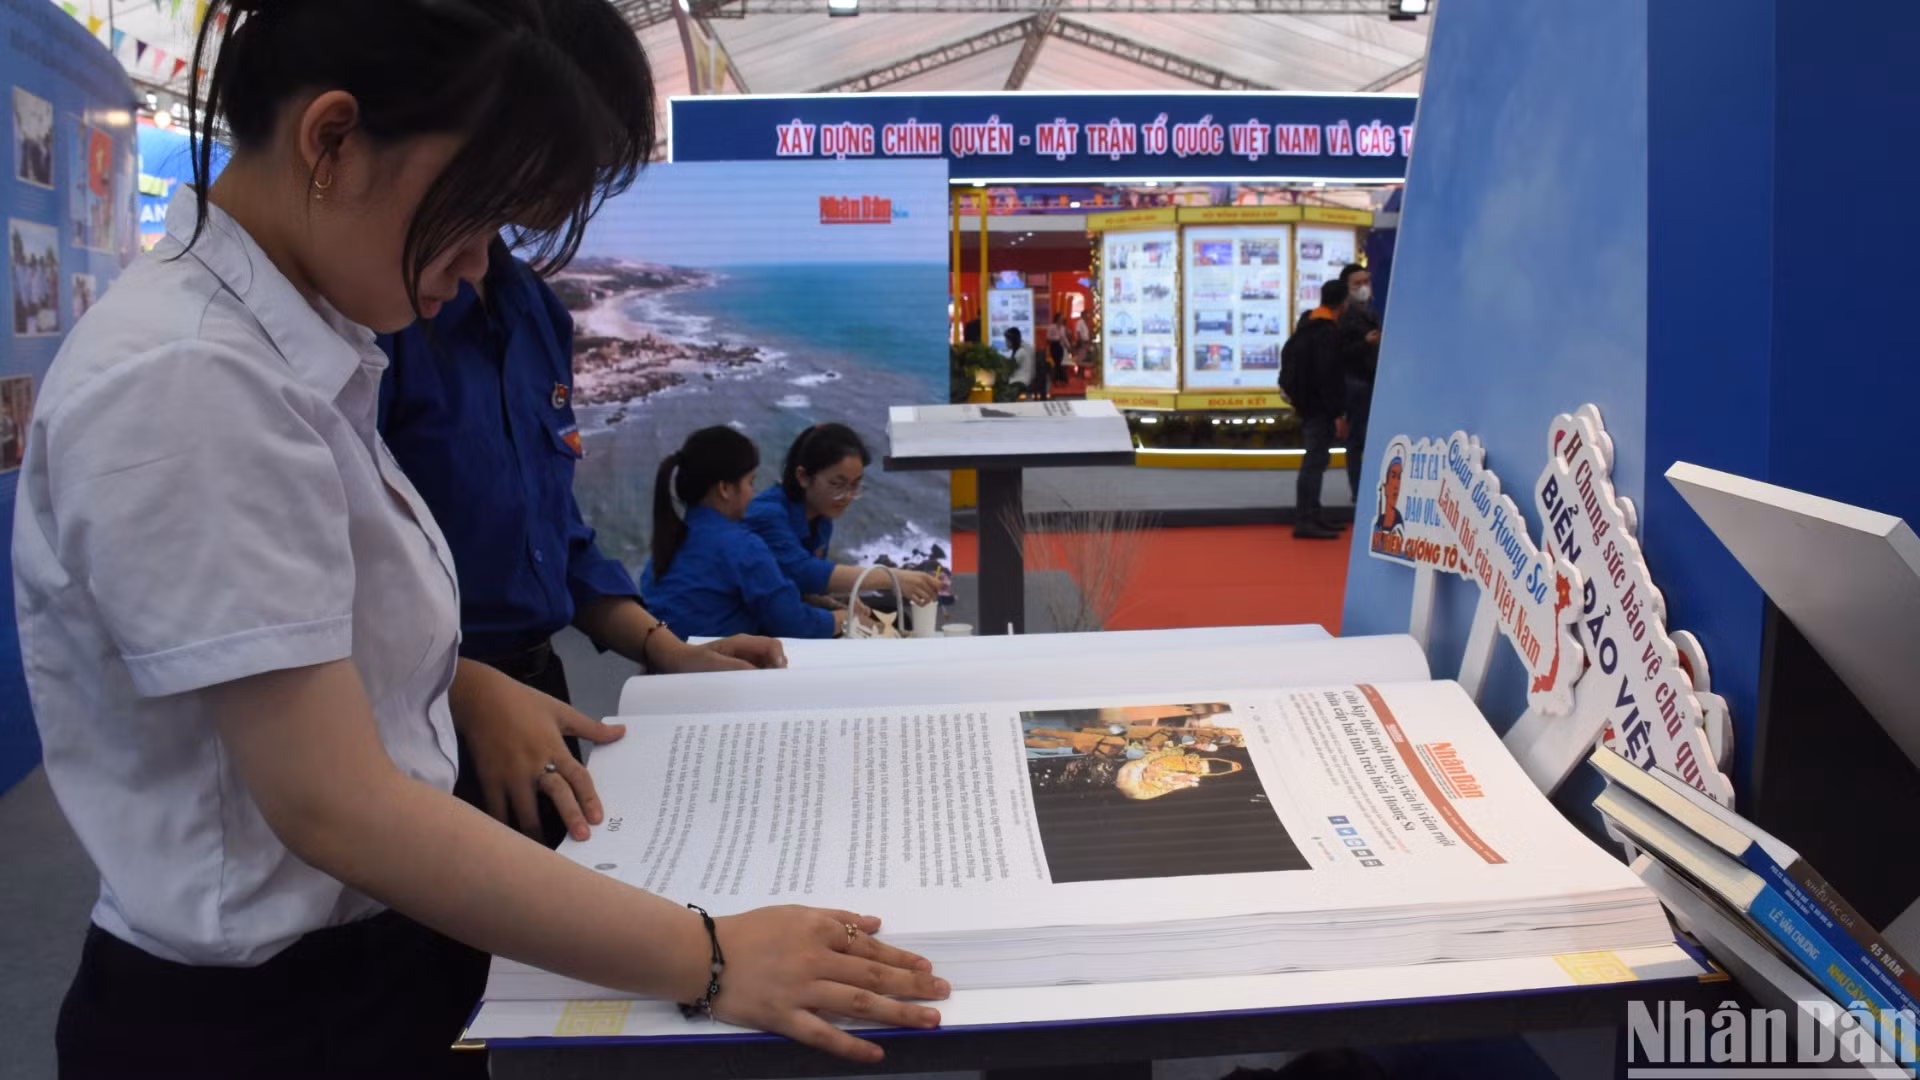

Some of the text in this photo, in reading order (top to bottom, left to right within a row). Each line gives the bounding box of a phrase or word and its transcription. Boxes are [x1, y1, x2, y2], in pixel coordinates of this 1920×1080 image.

[776, 118, 815, 156] XÂY
[820, 121, 874, 160] DỰNG
[883, 117, 942, 155] CHÍNH
[1036, 117, 1078, 160] MẶT
[1085, 117, 1137, 161] TRẬN
[1173, 114, 1224, 158] QUỐC
[1229, 118, 1271, 161] VIỆT
[1276, 123, 1321, 155] NAM
[1326, 119, 1353, 156] VÀ
[1357, 119, 1394, 156] CÁC
[1448, 438, 1473, 490] Quần
[1489, 504, 1529, 578] Hoàng
[1526, 563, 1548, 606] Sa
[1474, 546, 1493, 590] của
[1494, 570, 1517, 626] Việt
[1513, 604, 1542, 669] Nam
[1541, 474, 1582, 567] BIỂN
[1614, 675, 1657, 772] VIỆT
[1575, 459, 1610, 546] Chung
[1602, 540, 1627, 590] sức
[1620, 581, 1647, 642] bảo
[1641, 643, 1664, 682] vệ
[1655, 680, 1687, 741] chủ
[1429, 742, 1467, 775] Nhân
[1451, 774, 1486, 799] Dân
[608, 817, 623, 832] 209
[1769, 907, 1783, 921] LÊ
[1869, 943, 1904, 976] 45 NĂM
